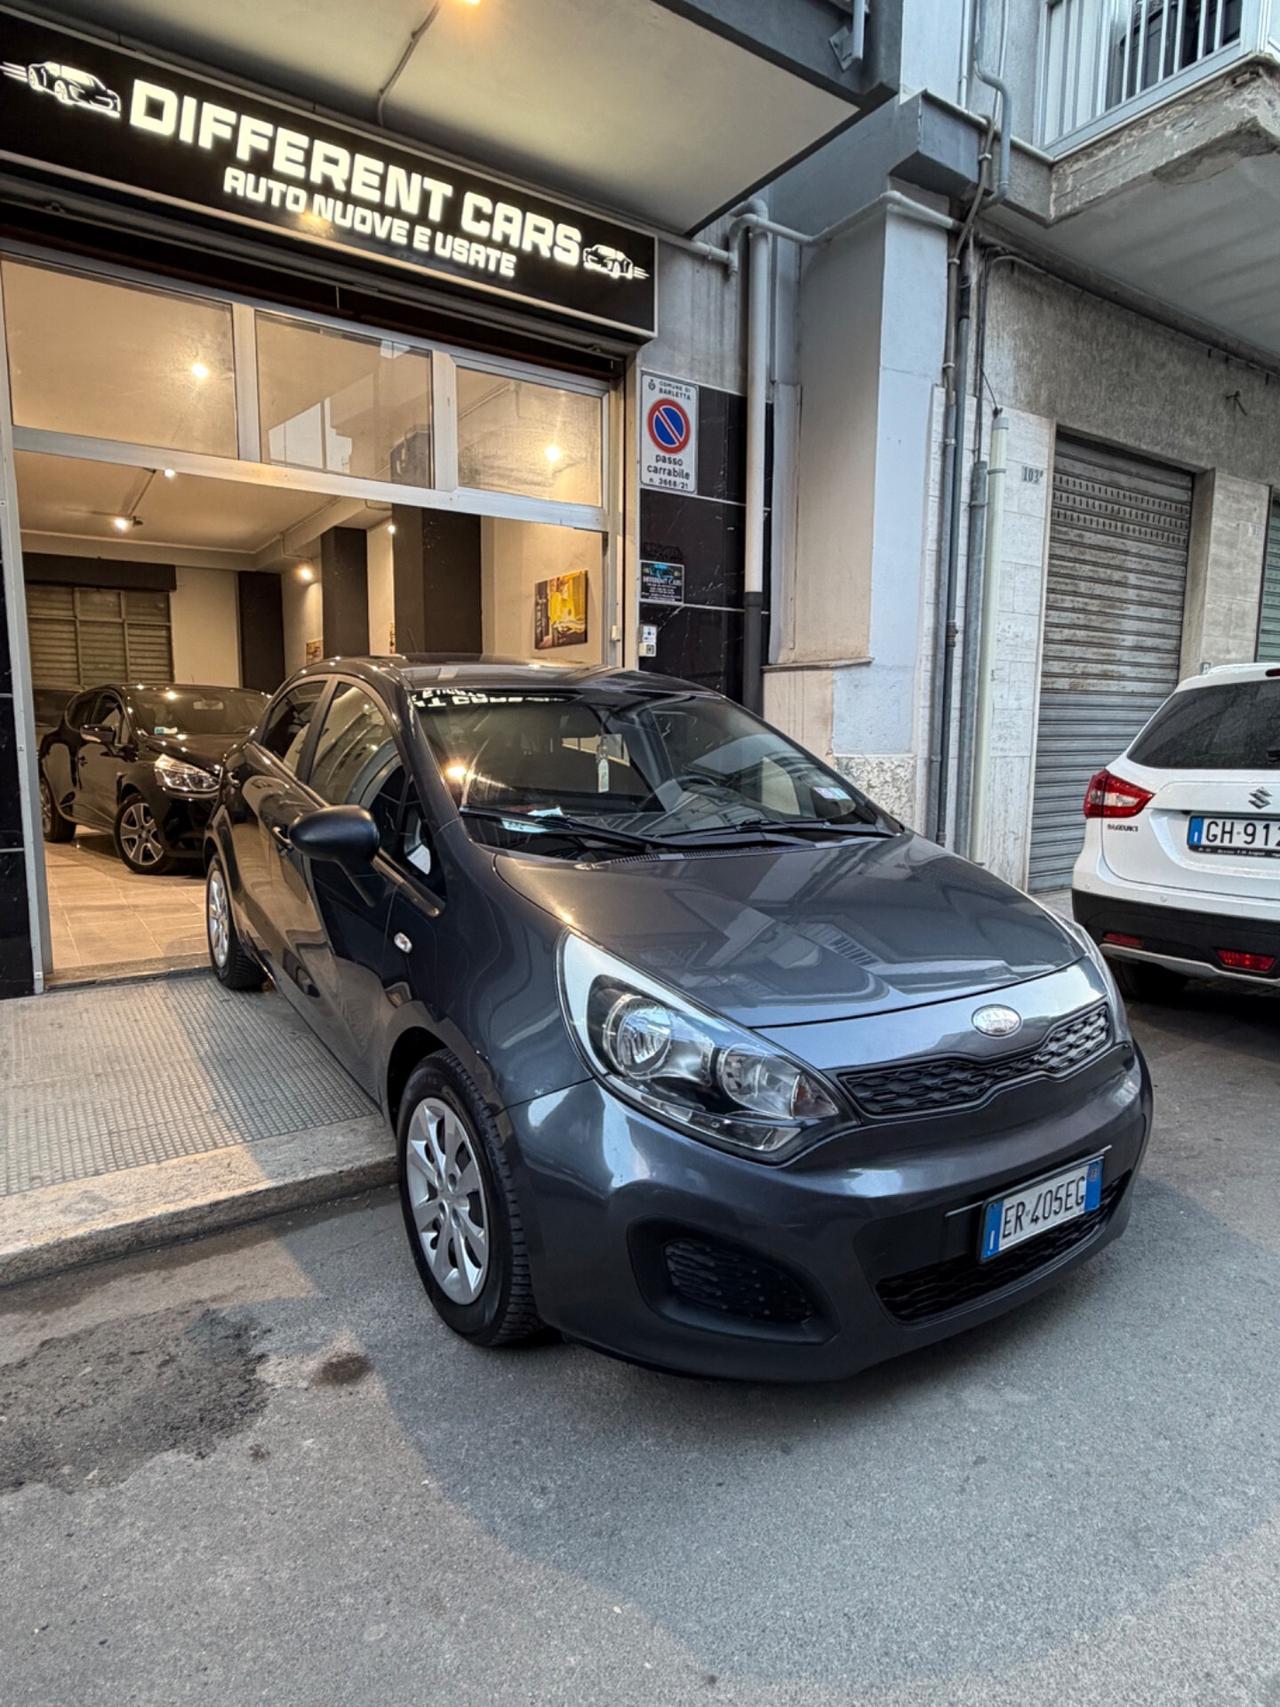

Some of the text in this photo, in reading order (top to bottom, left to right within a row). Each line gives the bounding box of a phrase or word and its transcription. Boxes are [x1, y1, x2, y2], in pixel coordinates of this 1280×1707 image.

[129, 79, 582, 267] DIFFERENT CARS
[223, 167, 517, 277] AUTO NUOVE E USATE
[659, 387, 691, 400] BARLETTA
[655, 454, 684, 466] passo
[646, 464, 691, 480] carrabile
